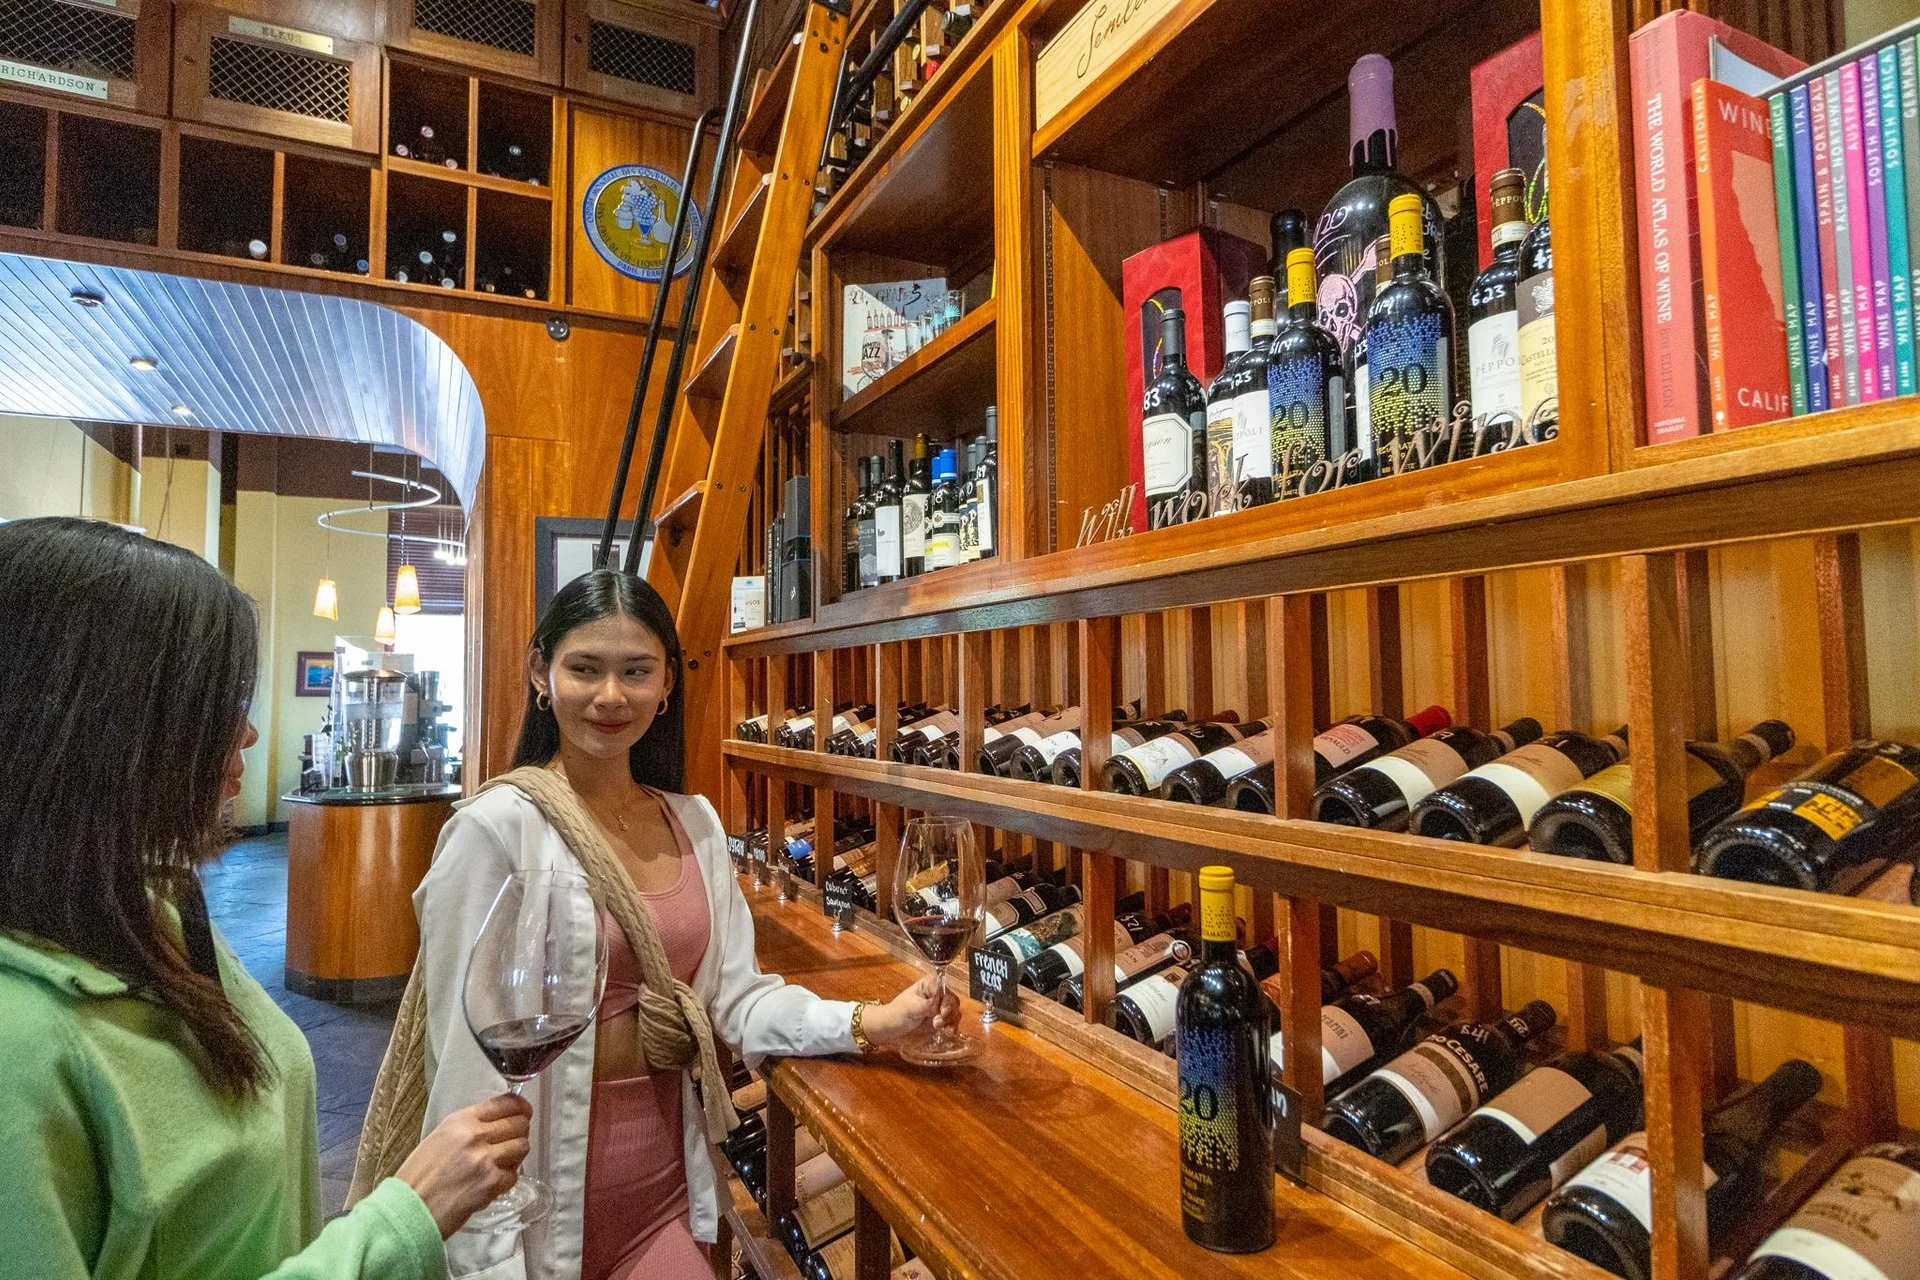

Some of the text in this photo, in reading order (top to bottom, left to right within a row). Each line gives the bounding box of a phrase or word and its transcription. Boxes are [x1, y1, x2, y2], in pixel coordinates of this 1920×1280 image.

[1, 64, 95, 92] RICHARDSON
[1862, 57, 1878, 130] AMERICA
[1880, 54, 1897, 108] AFRICA
[1900, 48, 1918, 119] GERMANY
[1647, 92, 1664, 131] THE
[1772, 100, 1785, 148] FRANCE
[1792, 95, 1806, 135] ITALY
[1810, 83, 1828, 168] PORTUGAL
[1826, 77, 1845, 168] NORTHWEST
[1841, 65, 1860, 151] AUSTRALIA
[1692, 84, 1709, 174] CALIFORNIA
[1884, 120, 1901, 170] SOUTH
[1649, 129, 1667, 194] WORLD
[1817, 168, 1829, 178] &
[1866, 139, 1882, 187] SOUTH
[1652, 196, 1670, 249] ATLAS
[1816, 182, 1832, 226] SPAIN
[1832, 176, 1848, 231] PACIFIC
[1654, 251, 1671, 274] OF
[1656, 276, 1673, 325] WINE
[1706, 294, 1718, 321] MAP
[1825, 292, 1837, 321] MAP
[1840, 289, 1852, 317] MAP
[1856, 285, 1869, 312] MAP
[1874, 280, 1887, 308] MAP
[1892, 275, 1906, 302] MAP
[1786, 303, 1799, 330] MAP
[1806, 301, 1817, 328] MAP
[1877, 312, 1890, 350] WINE
[1894, 308, 1909, 346] WINE
[1708, 325, 1721, 361] WINE
[1788, 333, 1802, 368] WINE
[1808, 332, 1822, 368] WINE
[1827, 325, 1841, 360] WINE
[1842, 322, 1857, 356] WINE
[1859, 316, 1873, 353] WINE
[1381, 362, 1428, 397] 20
[1275, 400, 1309, 430] 20
[1274, 439, 1365, 502] for
[1446, 1039, 1489, 1095] CESARE
